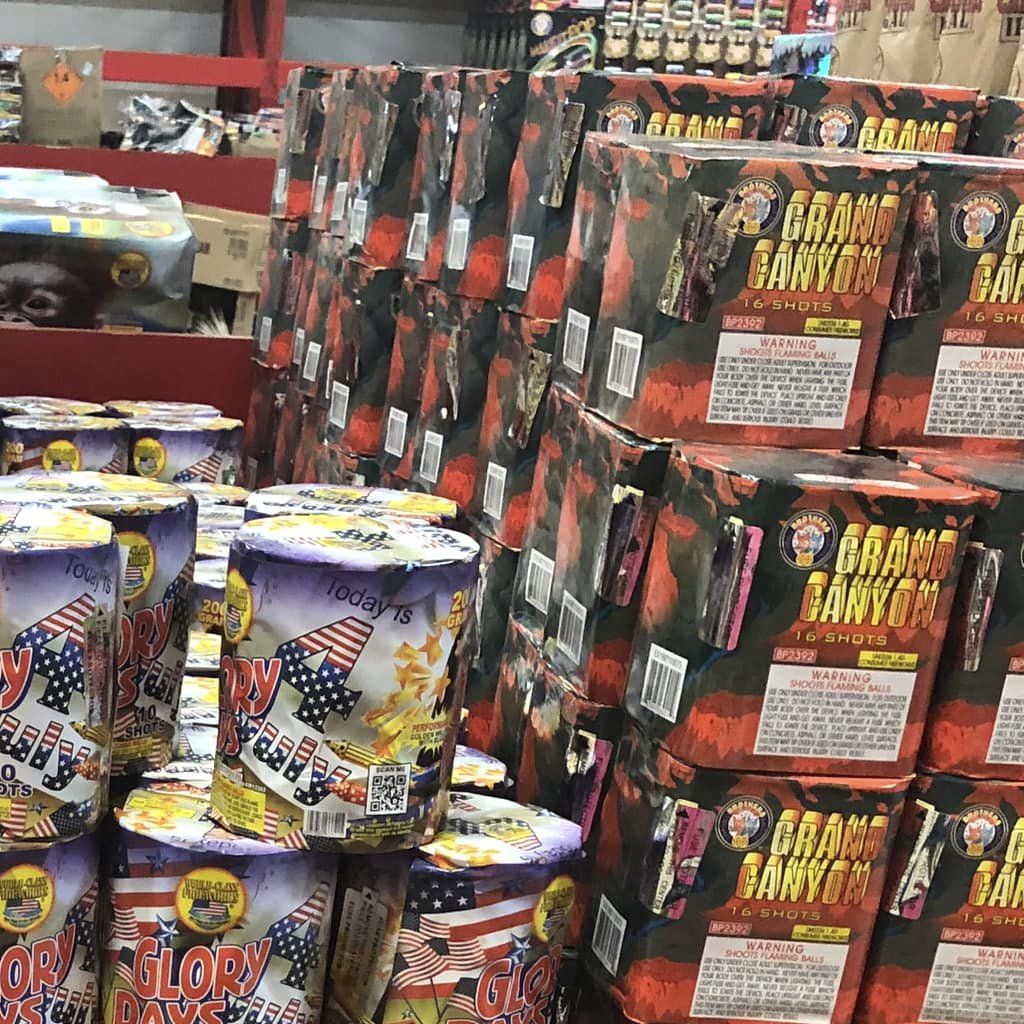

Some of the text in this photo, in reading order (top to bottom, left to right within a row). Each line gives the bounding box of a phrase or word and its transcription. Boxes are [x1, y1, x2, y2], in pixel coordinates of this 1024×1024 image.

[781, 189, 902, 246] GRAND
[746, 238, 883, 295] CANYON
[744, 299, 833, 313] 16 SHOTS
[759, 336, 817, 350] WARNING
[834, 522, 959, 581] GRAND
[327, 578, 414, 626] Today is
[798, 571, 941, 629] CANYON
[795, 630, 889, 647] 16 SHOTS
[276, 615, 376, 735] 4
[811, 669, 873, 684] WARNING
[125, 720, 166, 738] SHOTS
[137, 704, 157, 724] 10
[770, 807, 890, 862] GRAND
[734, 851, 873, 907] CANYON
[730, 906, 823, 921] 16 SHOTS
[725, 949, 825, 964] SHOOTS FLAMING BALLS
[745, 940, 805, 955] WARNING
[132, 936, 273, 1001] GLORY
